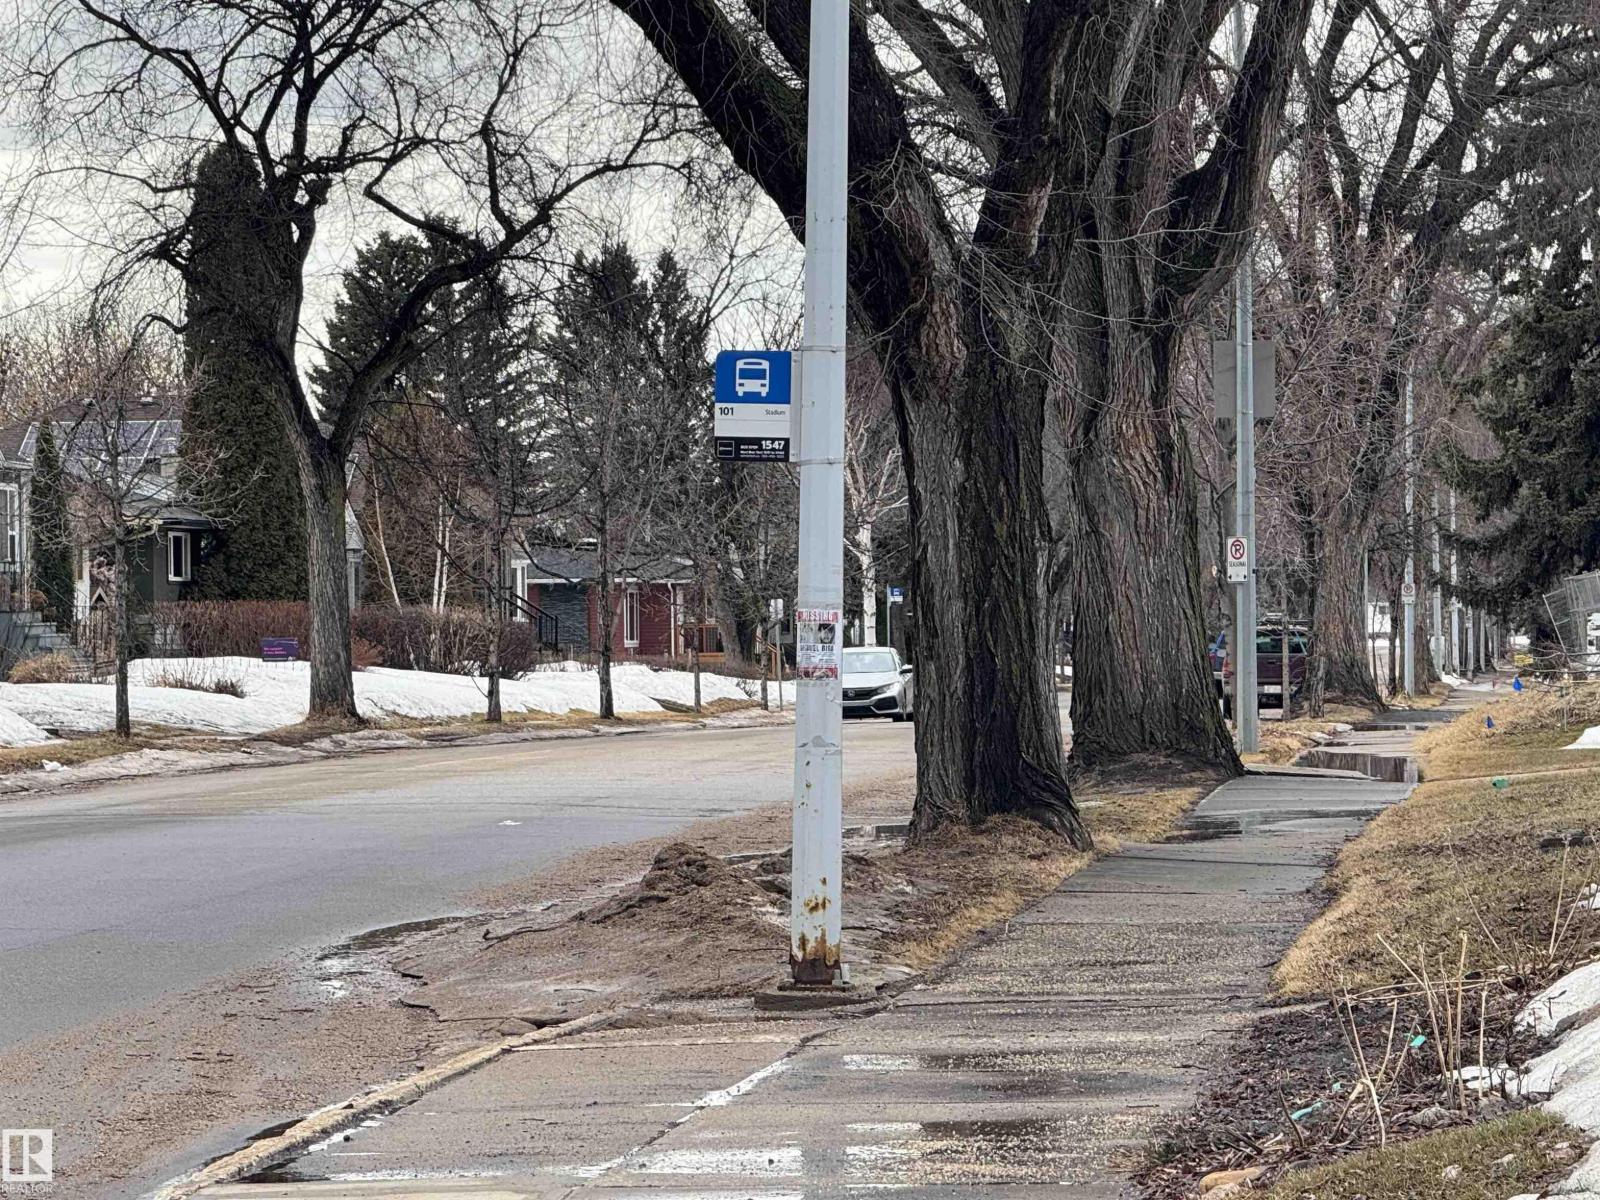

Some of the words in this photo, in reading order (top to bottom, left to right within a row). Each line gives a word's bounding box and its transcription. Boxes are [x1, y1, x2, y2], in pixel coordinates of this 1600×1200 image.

[719, 406, 734, 416] 101
[765, 408, 786, 416] Stadium
[761, 440, 785, 450] 1547
